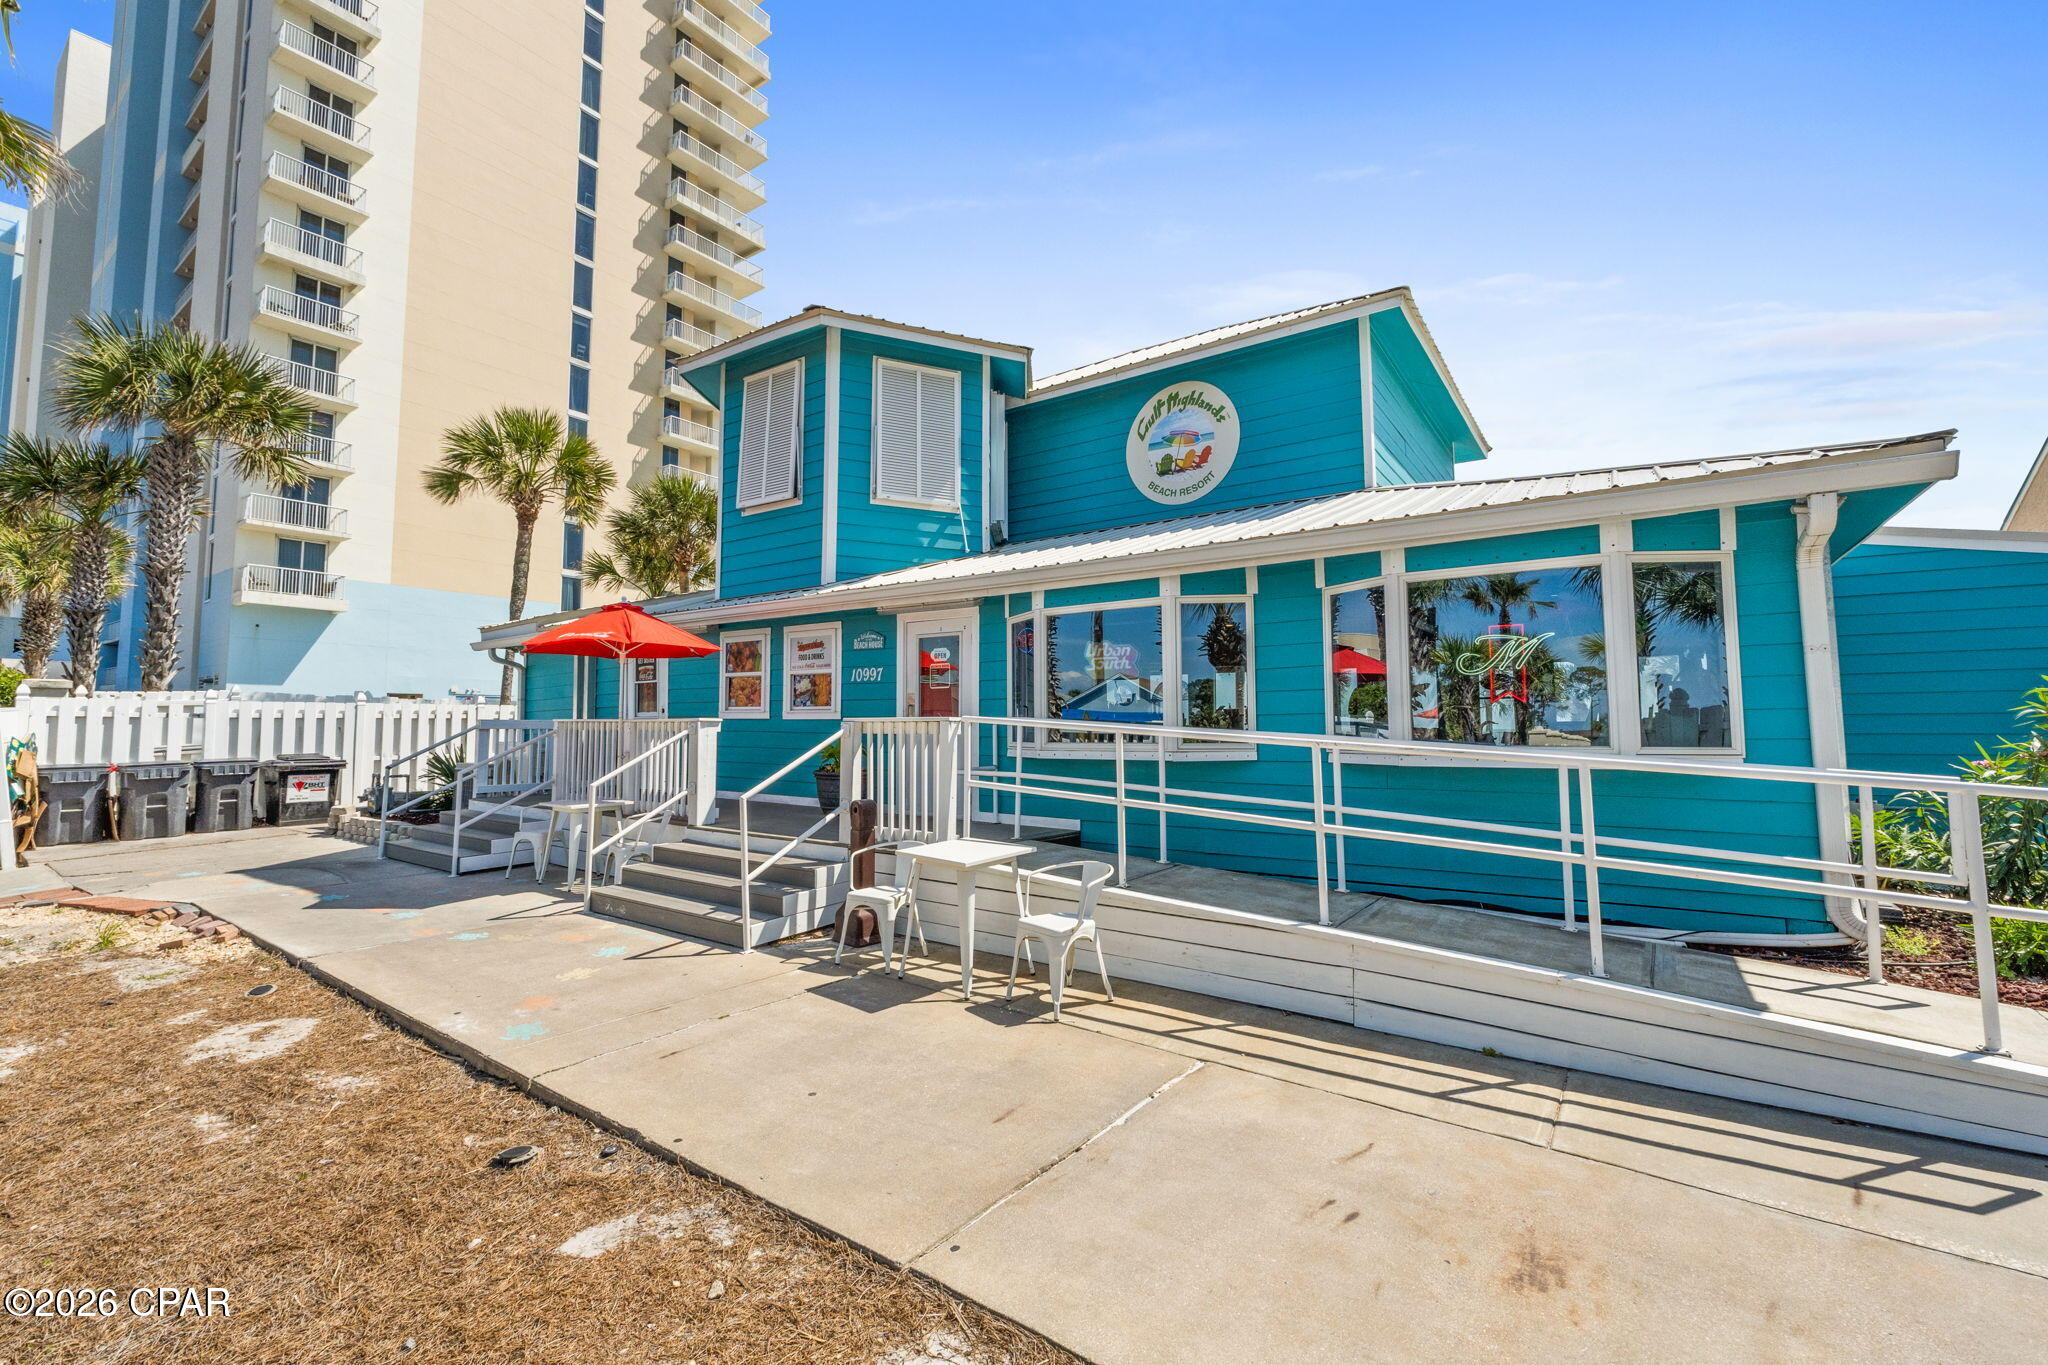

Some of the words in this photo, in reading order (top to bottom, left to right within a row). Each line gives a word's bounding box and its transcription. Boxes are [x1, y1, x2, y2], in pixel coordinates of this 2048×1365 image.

[1137, 398, 1166, 441] Gulf
[1167, 389, 1226, 423] Highlands
[1147, 481, 1177, 497] BEACH
[1179, 470, 1216, 497] RESORT
[798, 653, 808, 662] FOOD
[811, 652, 825, 661] DRINKS
[1086, 642, 1131, 658] Urban
[1086, 657, 1132, 671] South
[850, 667, 884, 682] 10997
